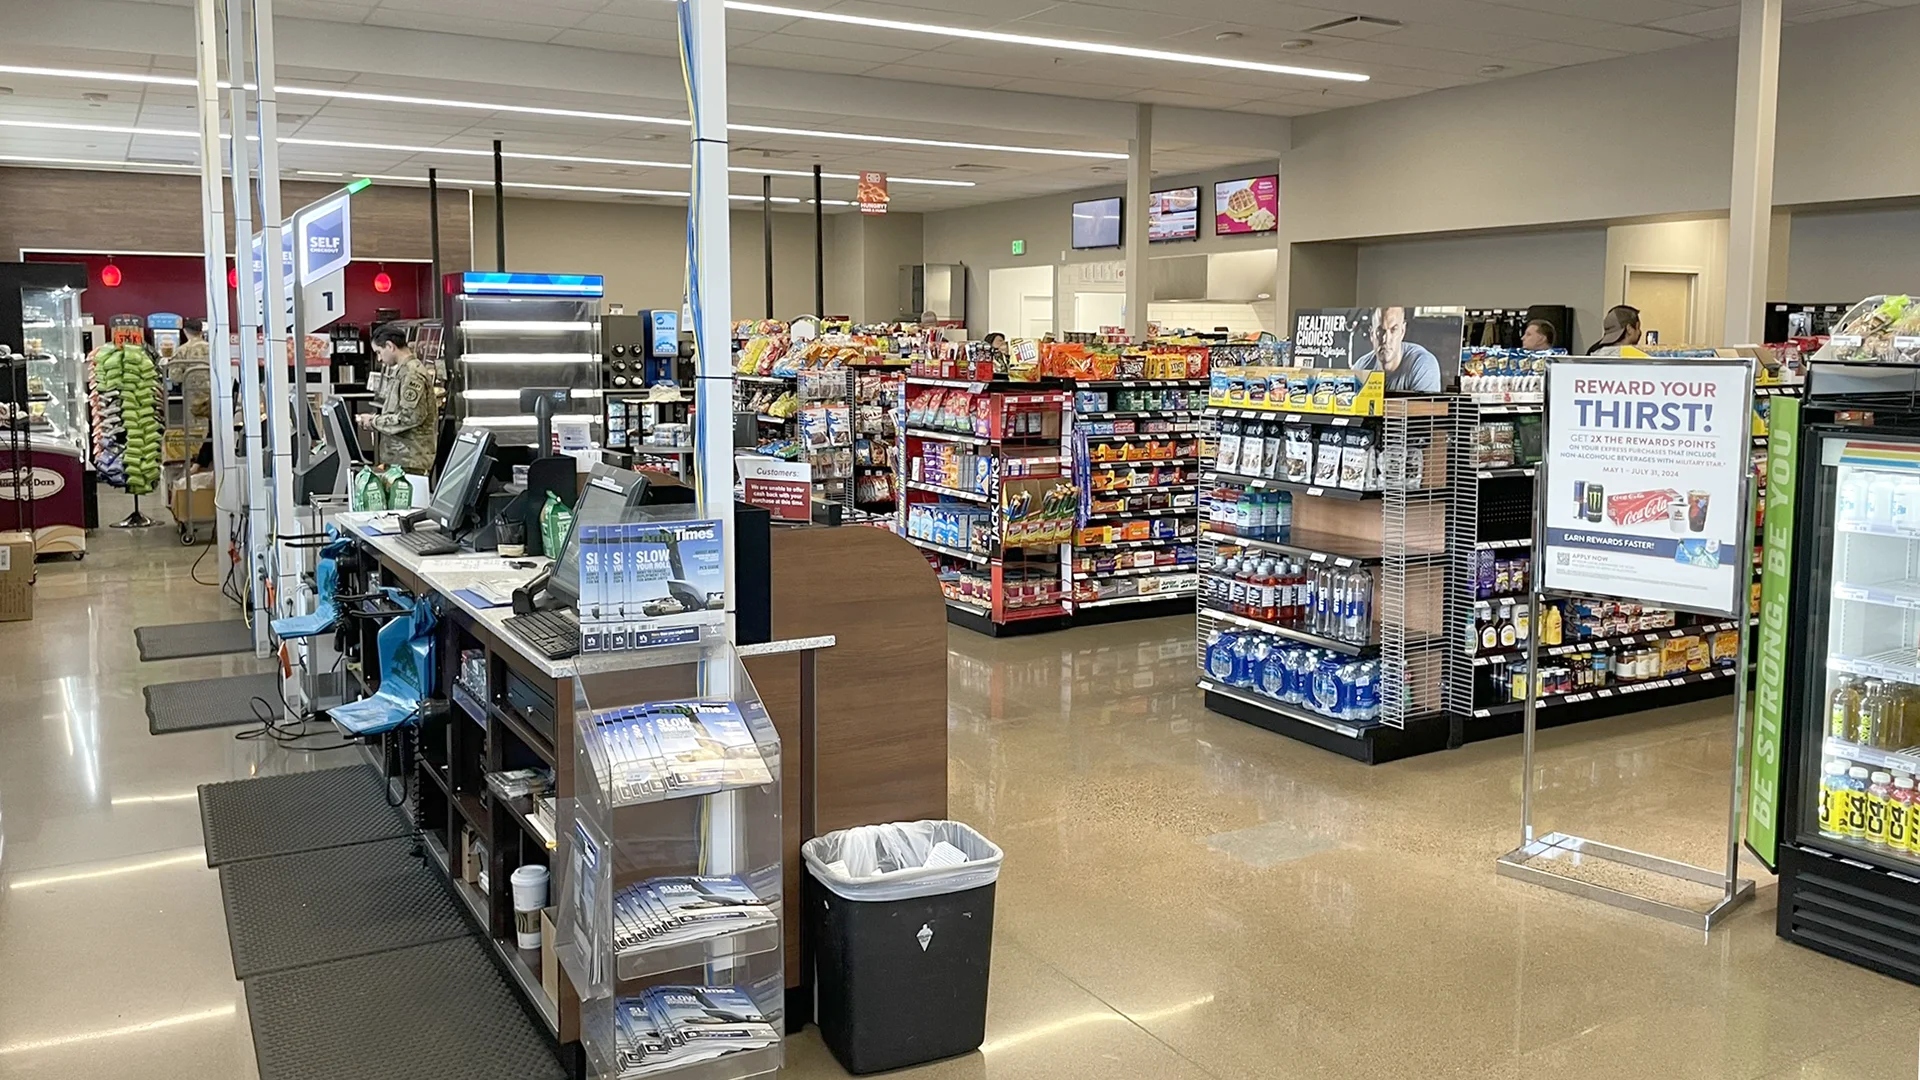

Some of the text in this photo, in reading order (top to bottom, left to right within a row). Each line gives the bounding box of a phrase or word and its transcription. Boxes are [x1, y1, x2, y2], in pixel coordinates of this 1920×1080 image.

[310, 236, 340, 248] SELF
[322, 292, 334, 311] 1
[1298, 316, 1346, 331] HEALTHIER
[1296, 330, 1334, 346] CHOICES
[1574, 379, 1716, 398] REWARD YOUR
[1574, 399, 1713, 432] THIRST!
[1570, 434, 1716, 449] GET 2X THE REWARDS POINTS
[1560, 452, 1616, 461] NON-ALCOHOLIC
[1617, 455, 1655, 463] BEVERAGES
[1581, 444, 1599, 452] YOUR
[1628, 446, 1666, 455] PURCHASES
[1686, 450, 1716, 458] INCLUDE
[756, 468, 800, 478] Customers:
[991, 505, 1000, 544] JACK
[642, 528, 714, 544] Army Times
[1564, 534, 1584, 542] EARN
[1586, 536, 1623, 546] REWARDS
[636, 549, 670, 563] SLOW
[1753, 430, 1792, 830] BE STRONG, BE YOU
[690, 705, 730, 714] Times
[656, 718, 691, 727] SLOW
[1850, 796, 1865, 828] C4
[1868, 800, 1884, 834] C4
[1890, 806, 1904, 840] C4
[659, 884, 692, 892] SLOW
